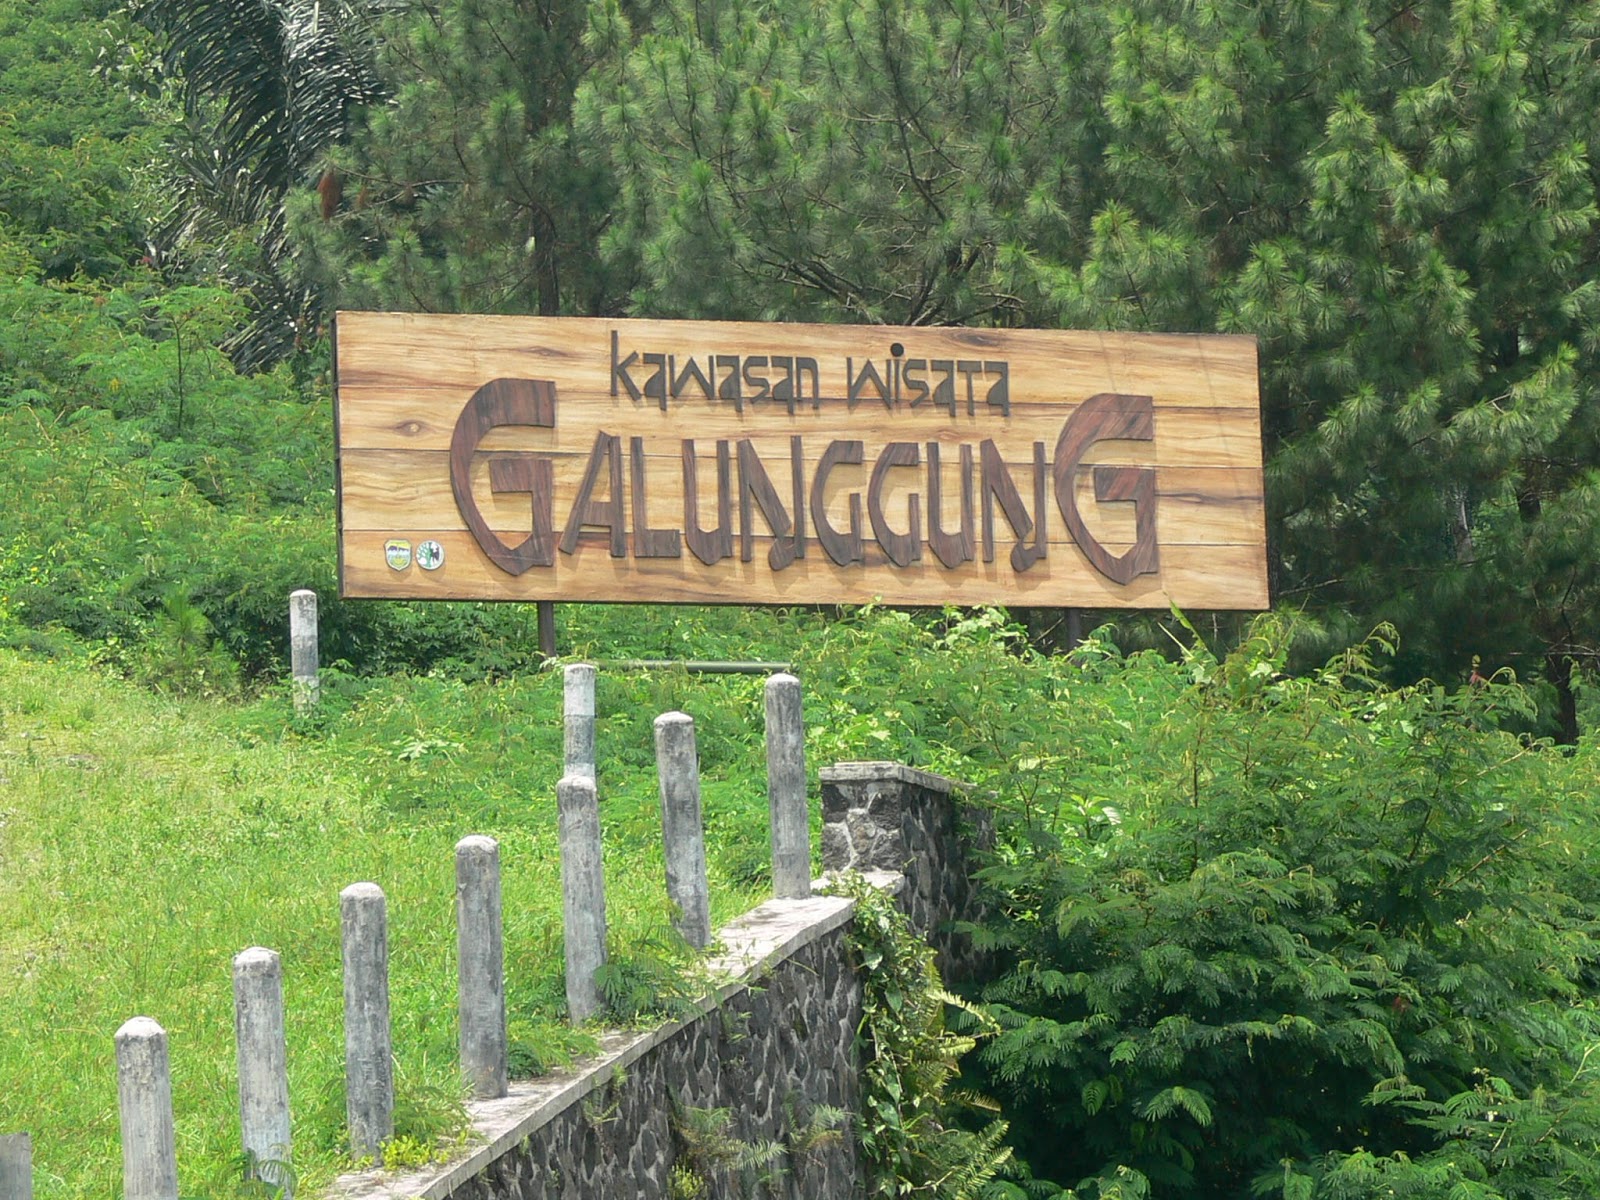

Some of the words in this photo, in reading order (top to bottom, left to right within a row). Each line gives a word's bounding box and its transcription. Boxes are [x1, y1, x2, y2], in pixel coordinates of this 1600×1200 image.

[611, 330, 818, 414] kawasan
[847, 342, 1009, 417] wisata
[450, 377, 1159, 586] GALUNGGUNG
